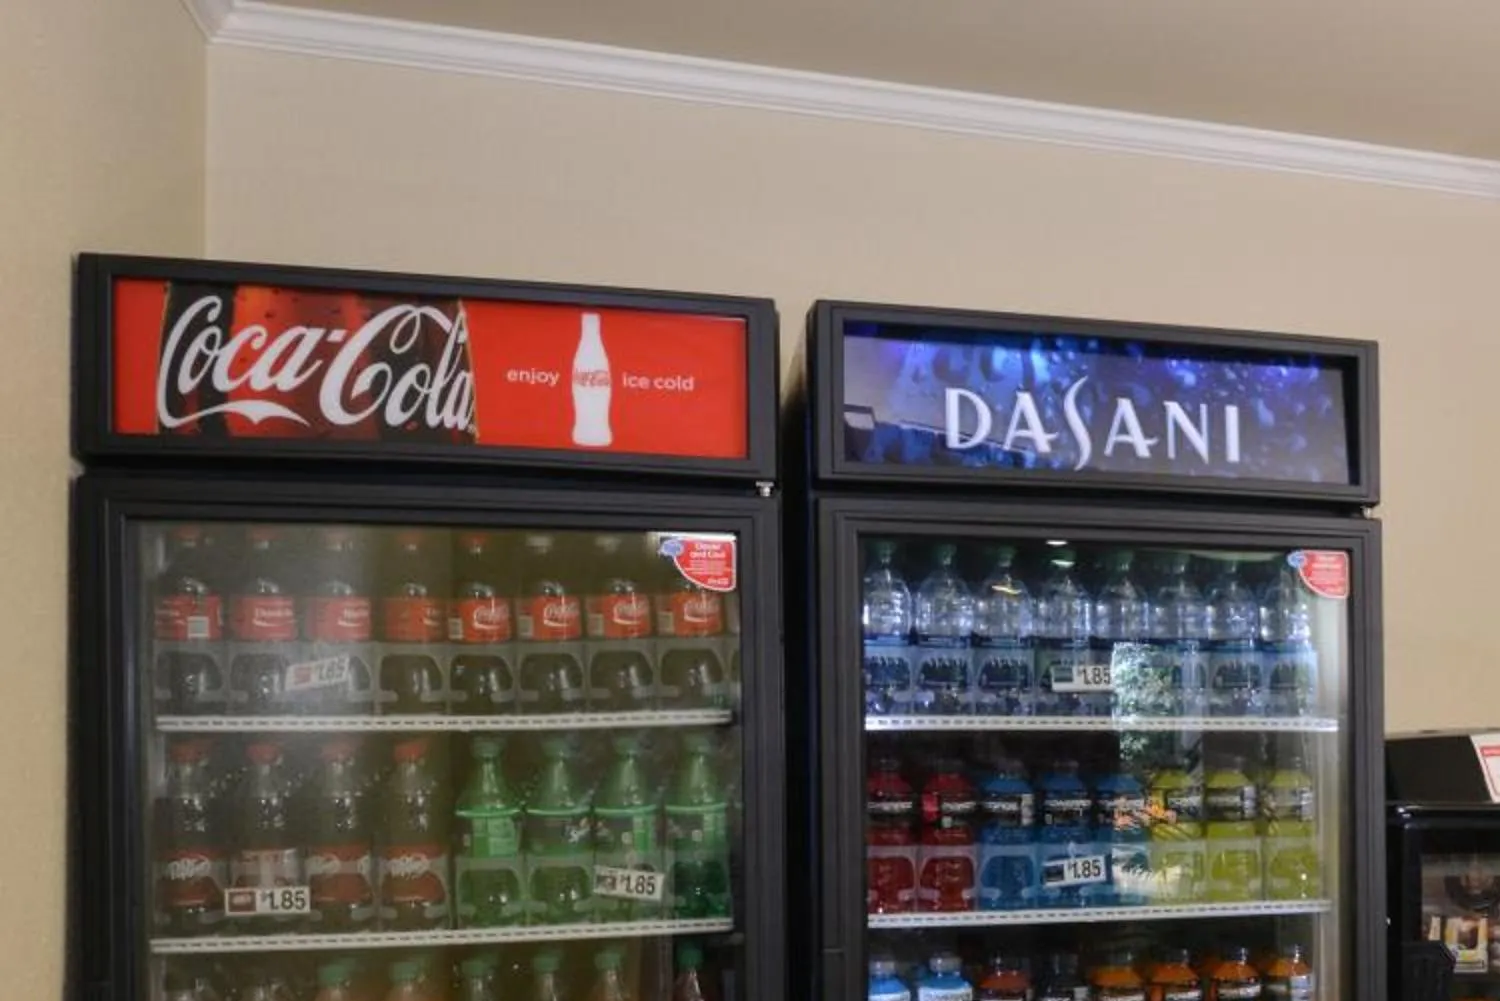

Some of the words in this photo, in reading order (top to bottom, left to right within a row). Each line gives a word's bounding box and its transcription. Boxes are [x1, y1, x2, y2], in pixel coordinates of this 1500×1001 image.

[158, 295, 476, 431] Coca-Cola
[507, 367, 560, 387] enjoy
[622, 372, 647, 389] ice
[653, 373, 695, 391] cold
[944, 376, 1241, 470] DASANI
